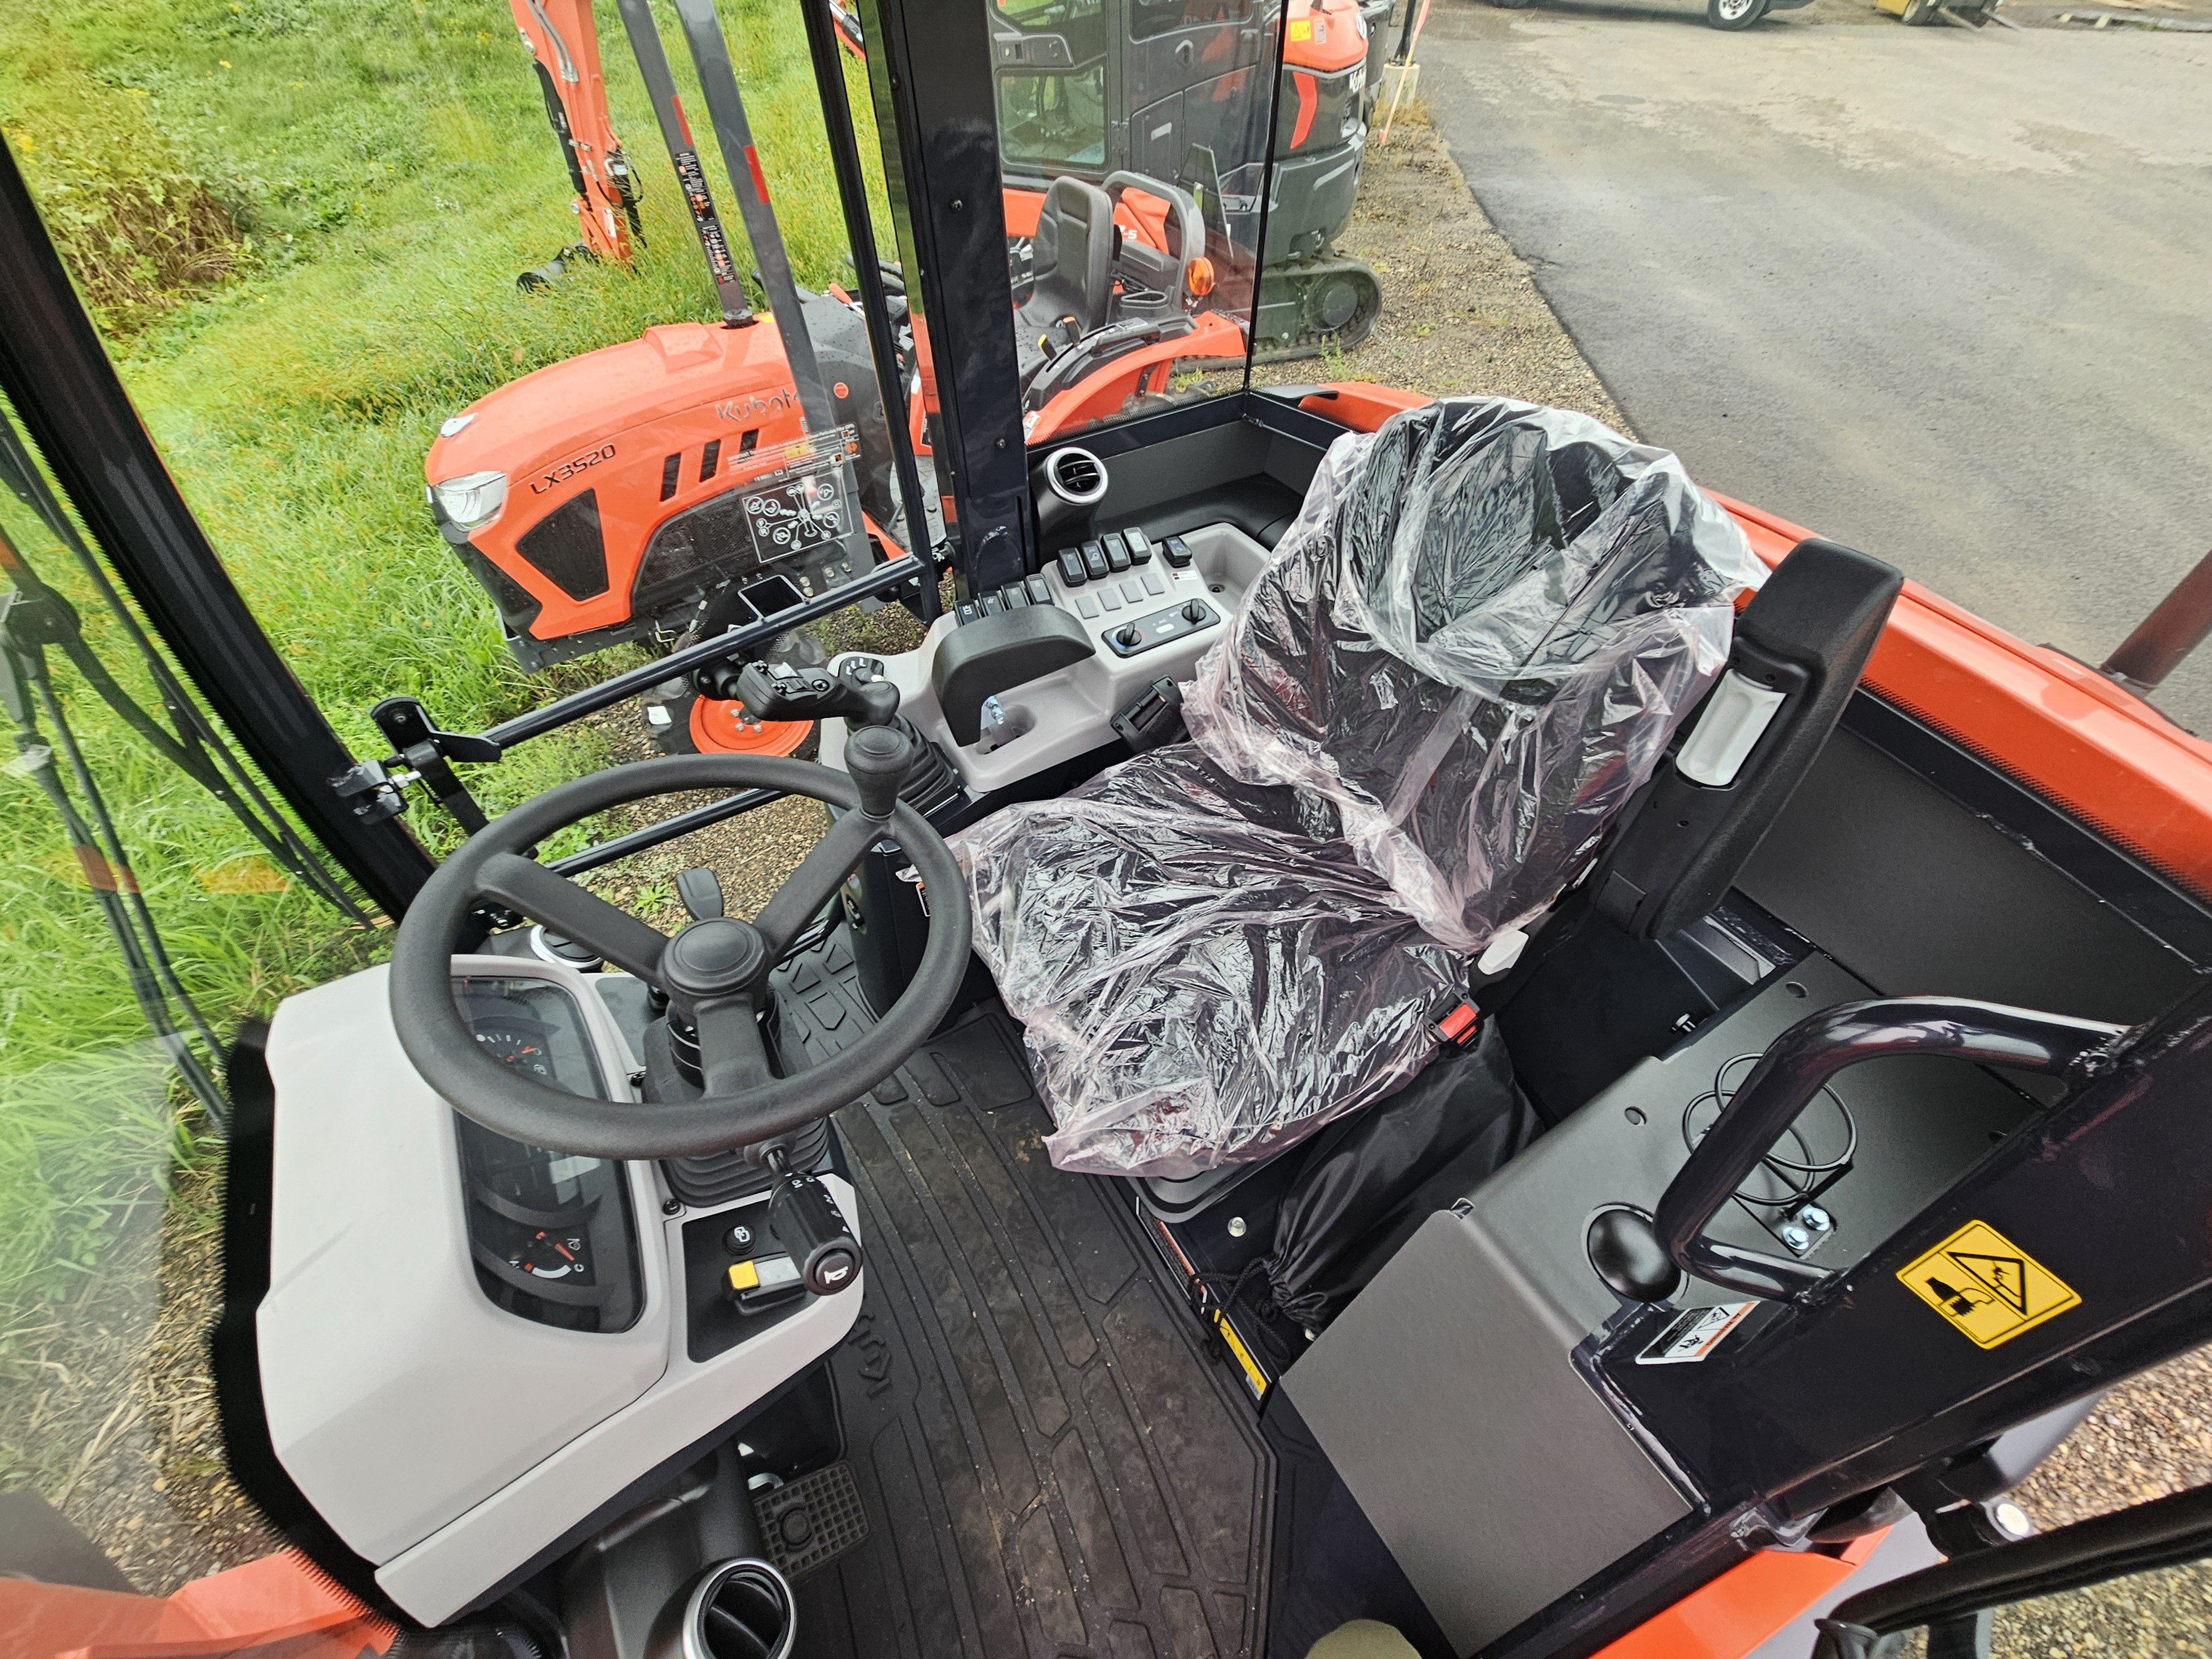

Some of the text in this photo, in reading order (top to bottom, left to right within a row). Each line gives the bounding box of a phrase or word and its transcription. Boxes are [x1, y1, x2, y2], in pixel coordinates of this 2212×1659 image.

[715, 388, 798, 422] Kubot
[529, 444, 616, 494] LX3520
[848, 1313, 893, 1398] Kub
